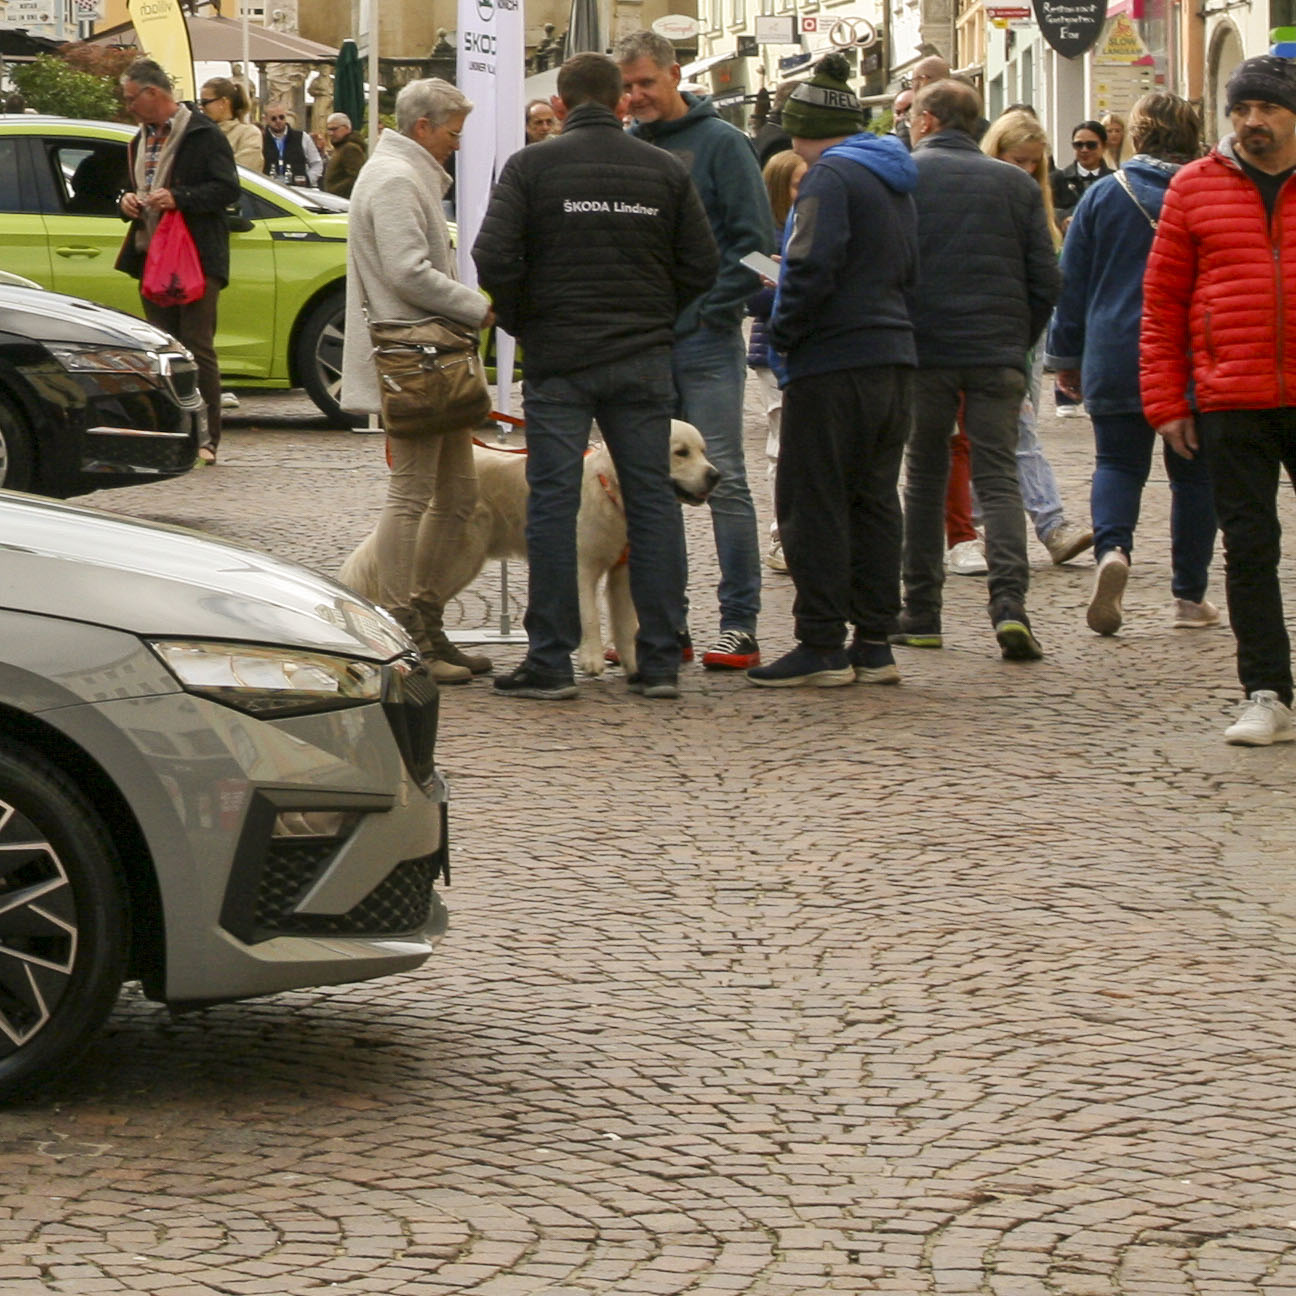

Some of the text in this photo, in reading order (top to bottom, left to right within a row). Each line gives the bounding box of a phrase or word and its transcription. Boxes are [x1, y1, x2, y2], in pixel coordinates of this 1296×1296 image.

[1109, 37, 1137, 46] SLOW
[563, 199, 660, 216] ŠKODA Lindner
